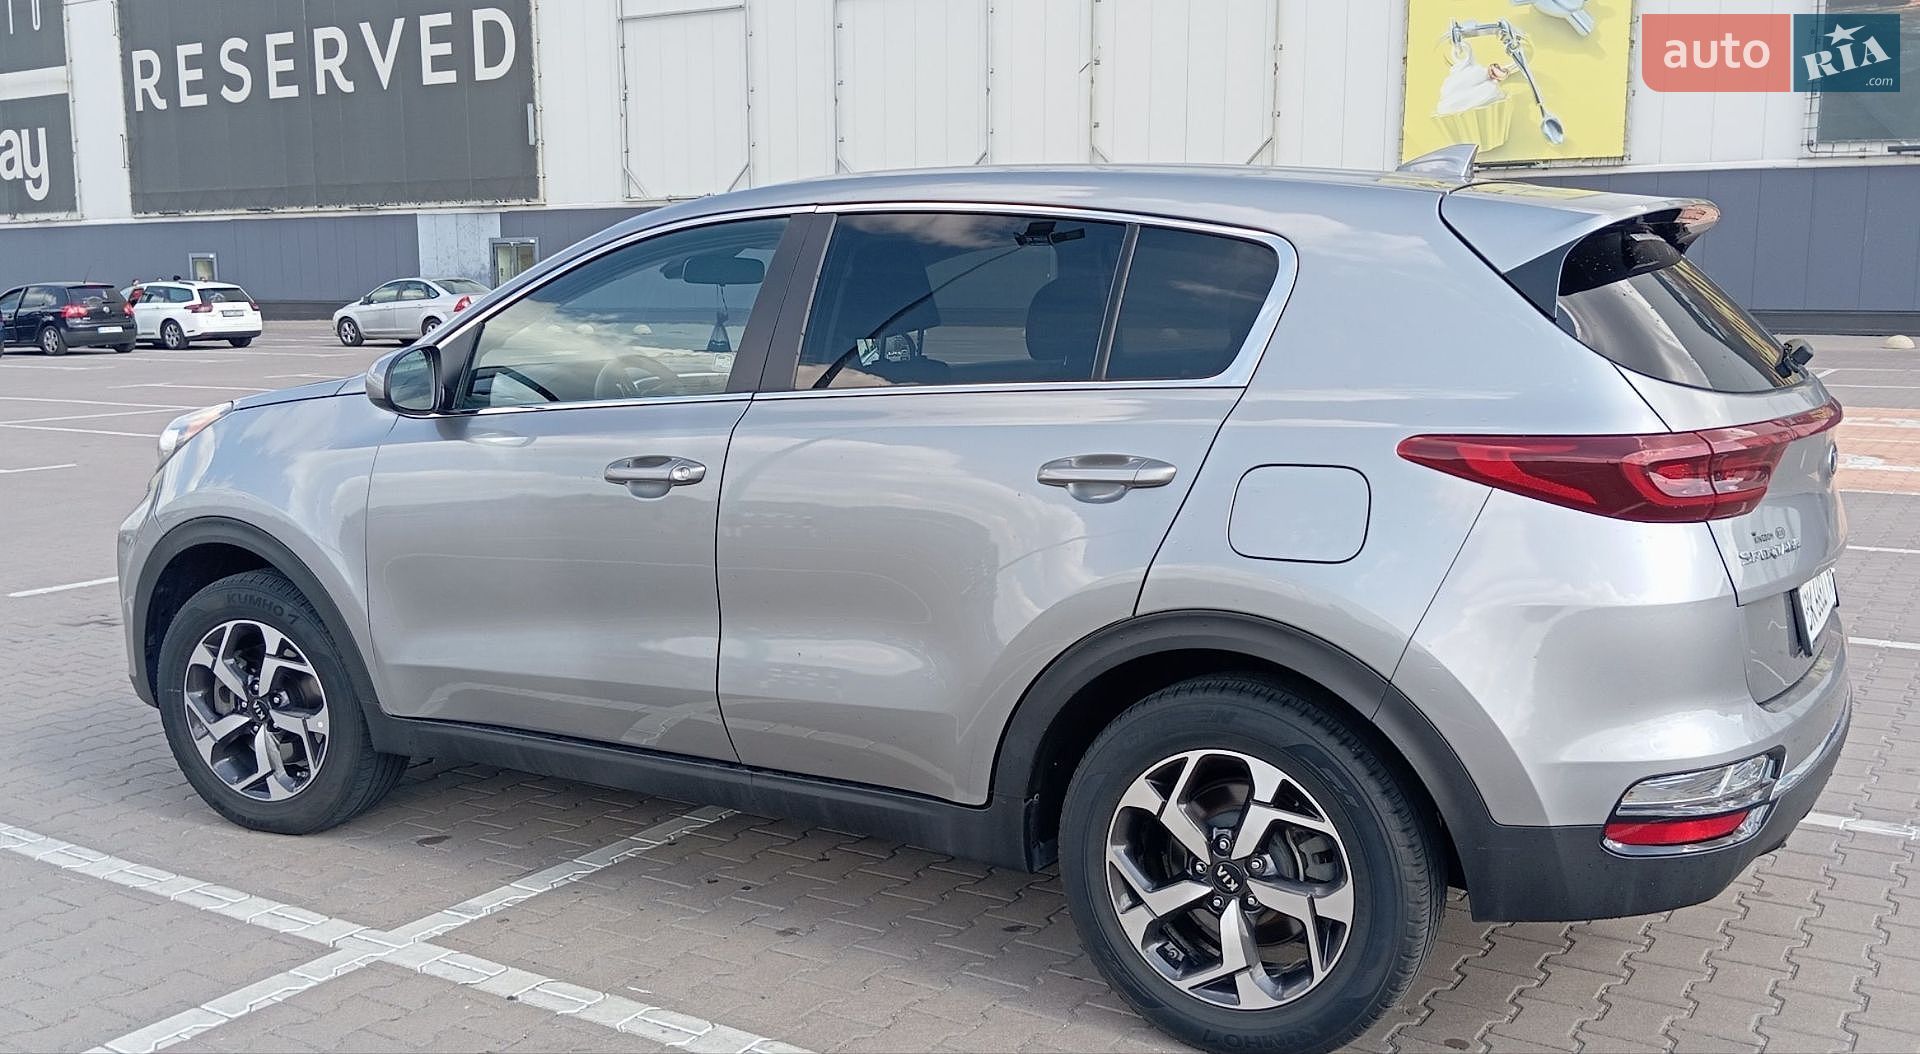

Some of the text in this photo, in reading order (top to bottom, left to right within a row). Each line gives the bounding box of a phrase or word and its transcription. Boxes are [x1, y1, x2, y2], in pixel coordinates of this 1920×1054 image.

[131, 7, 516, 112] RESERVED
[226, 592, 284, 617] KUMHO
[253, 701, 266, 720] KIA
[1217, 865, 1239, 892] KIA
